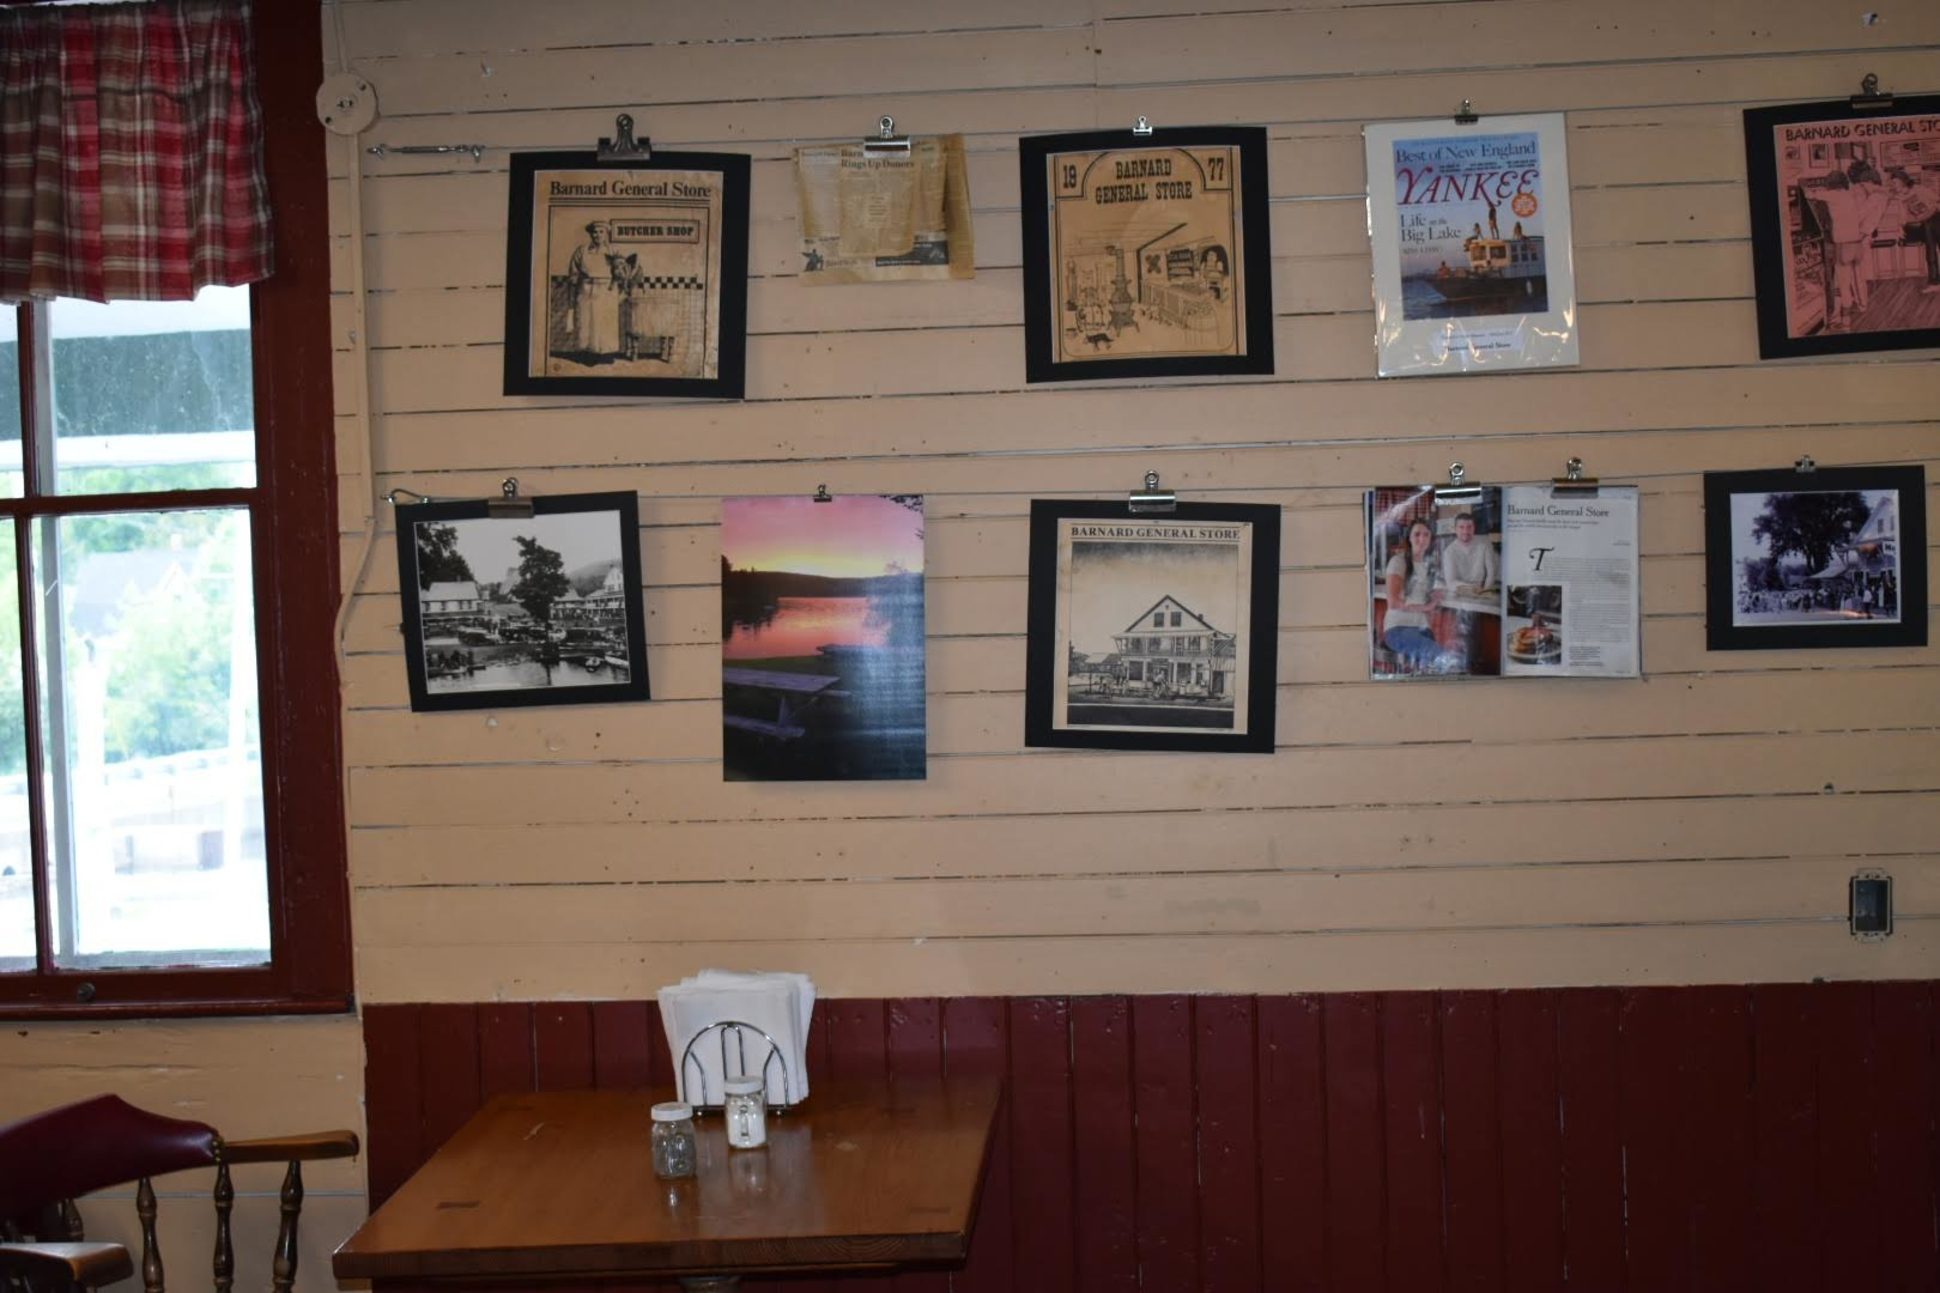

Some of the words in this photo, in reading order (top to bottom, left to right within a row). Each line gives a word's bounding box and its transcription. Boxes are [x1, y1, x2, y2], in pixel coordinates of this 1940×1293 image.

[1786, 125, 1850, 142] BARNARD
[1854, 122, 1915, 136] GENERAL
[1396, 149, 1425, 163] Best
[1428, 146, 1442, 160] of
[1446, 145, 1479, 159] New
[1481, 141, 1536, 160] England
[868, 160, 881, 169] Up
[1116, 158, 1172, 180] BARNARD
[1208, 158, 1224, 181] 77
[1063, 165, 1077, 188] 19
[1396, 166, 1540, 207] YANKEE
[550, 180, 607, 196] Barnard
[612, 180, 668, 196] General
[672, 182, 712, 198] Store
[1096, 182, 1148, 205] GENERAL
[1156, 181, 1193, 200] STORE
[1400, 213, 1426, 228] Life
[617, 226, 664, 236] BUTCHER
[666, 226, 694, 236] SHOP
[1402, 228, 1425, 244] Big
[1429, 226, 1461, 240] Lake
[1507, 504, 1544, 516] Barnard
[1546, 505, 1583, 517] General
[1585, 506, 1610, 518] Store
[1072, 526, 1134, 538] BARNARD
[1136, 527, 1196, 538] GENERAL
[1200, 528, 1240, 540] STORE
[1529, 546, 1554, 571] T
